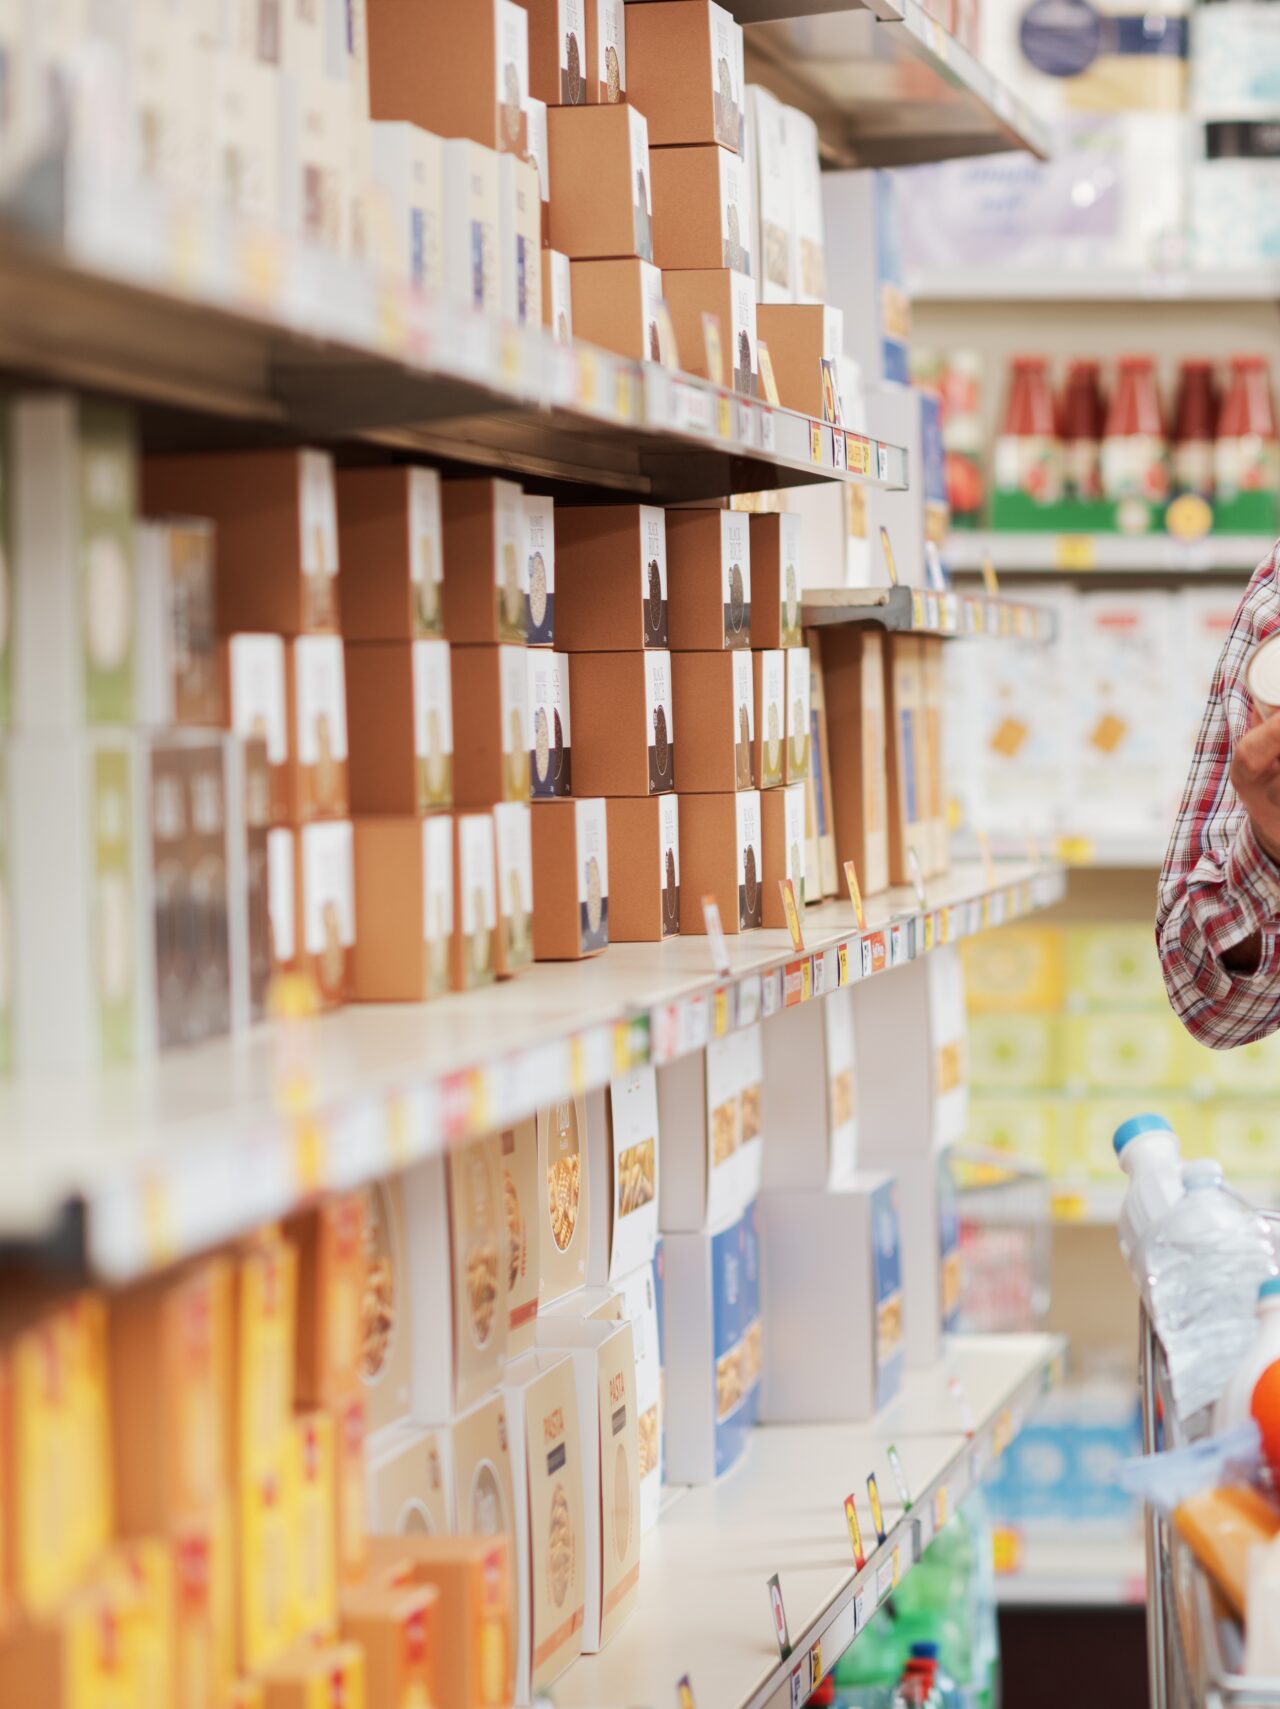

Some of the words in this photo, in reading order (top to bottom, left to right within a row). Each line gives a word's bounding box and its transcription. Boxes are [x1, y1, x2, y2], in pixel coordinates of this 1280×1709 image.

[648, 521, 659, 536] BLACK
[648, 536, 660, 557] RICE
[729, 542, 742, 561] RICE
[652, 666, 664, 682] BLACK
[653, 682, 665, 702] RICE
[609, 1369, 625, 1409] PASTA
[543, 1406, 565, 1445] PASTA
